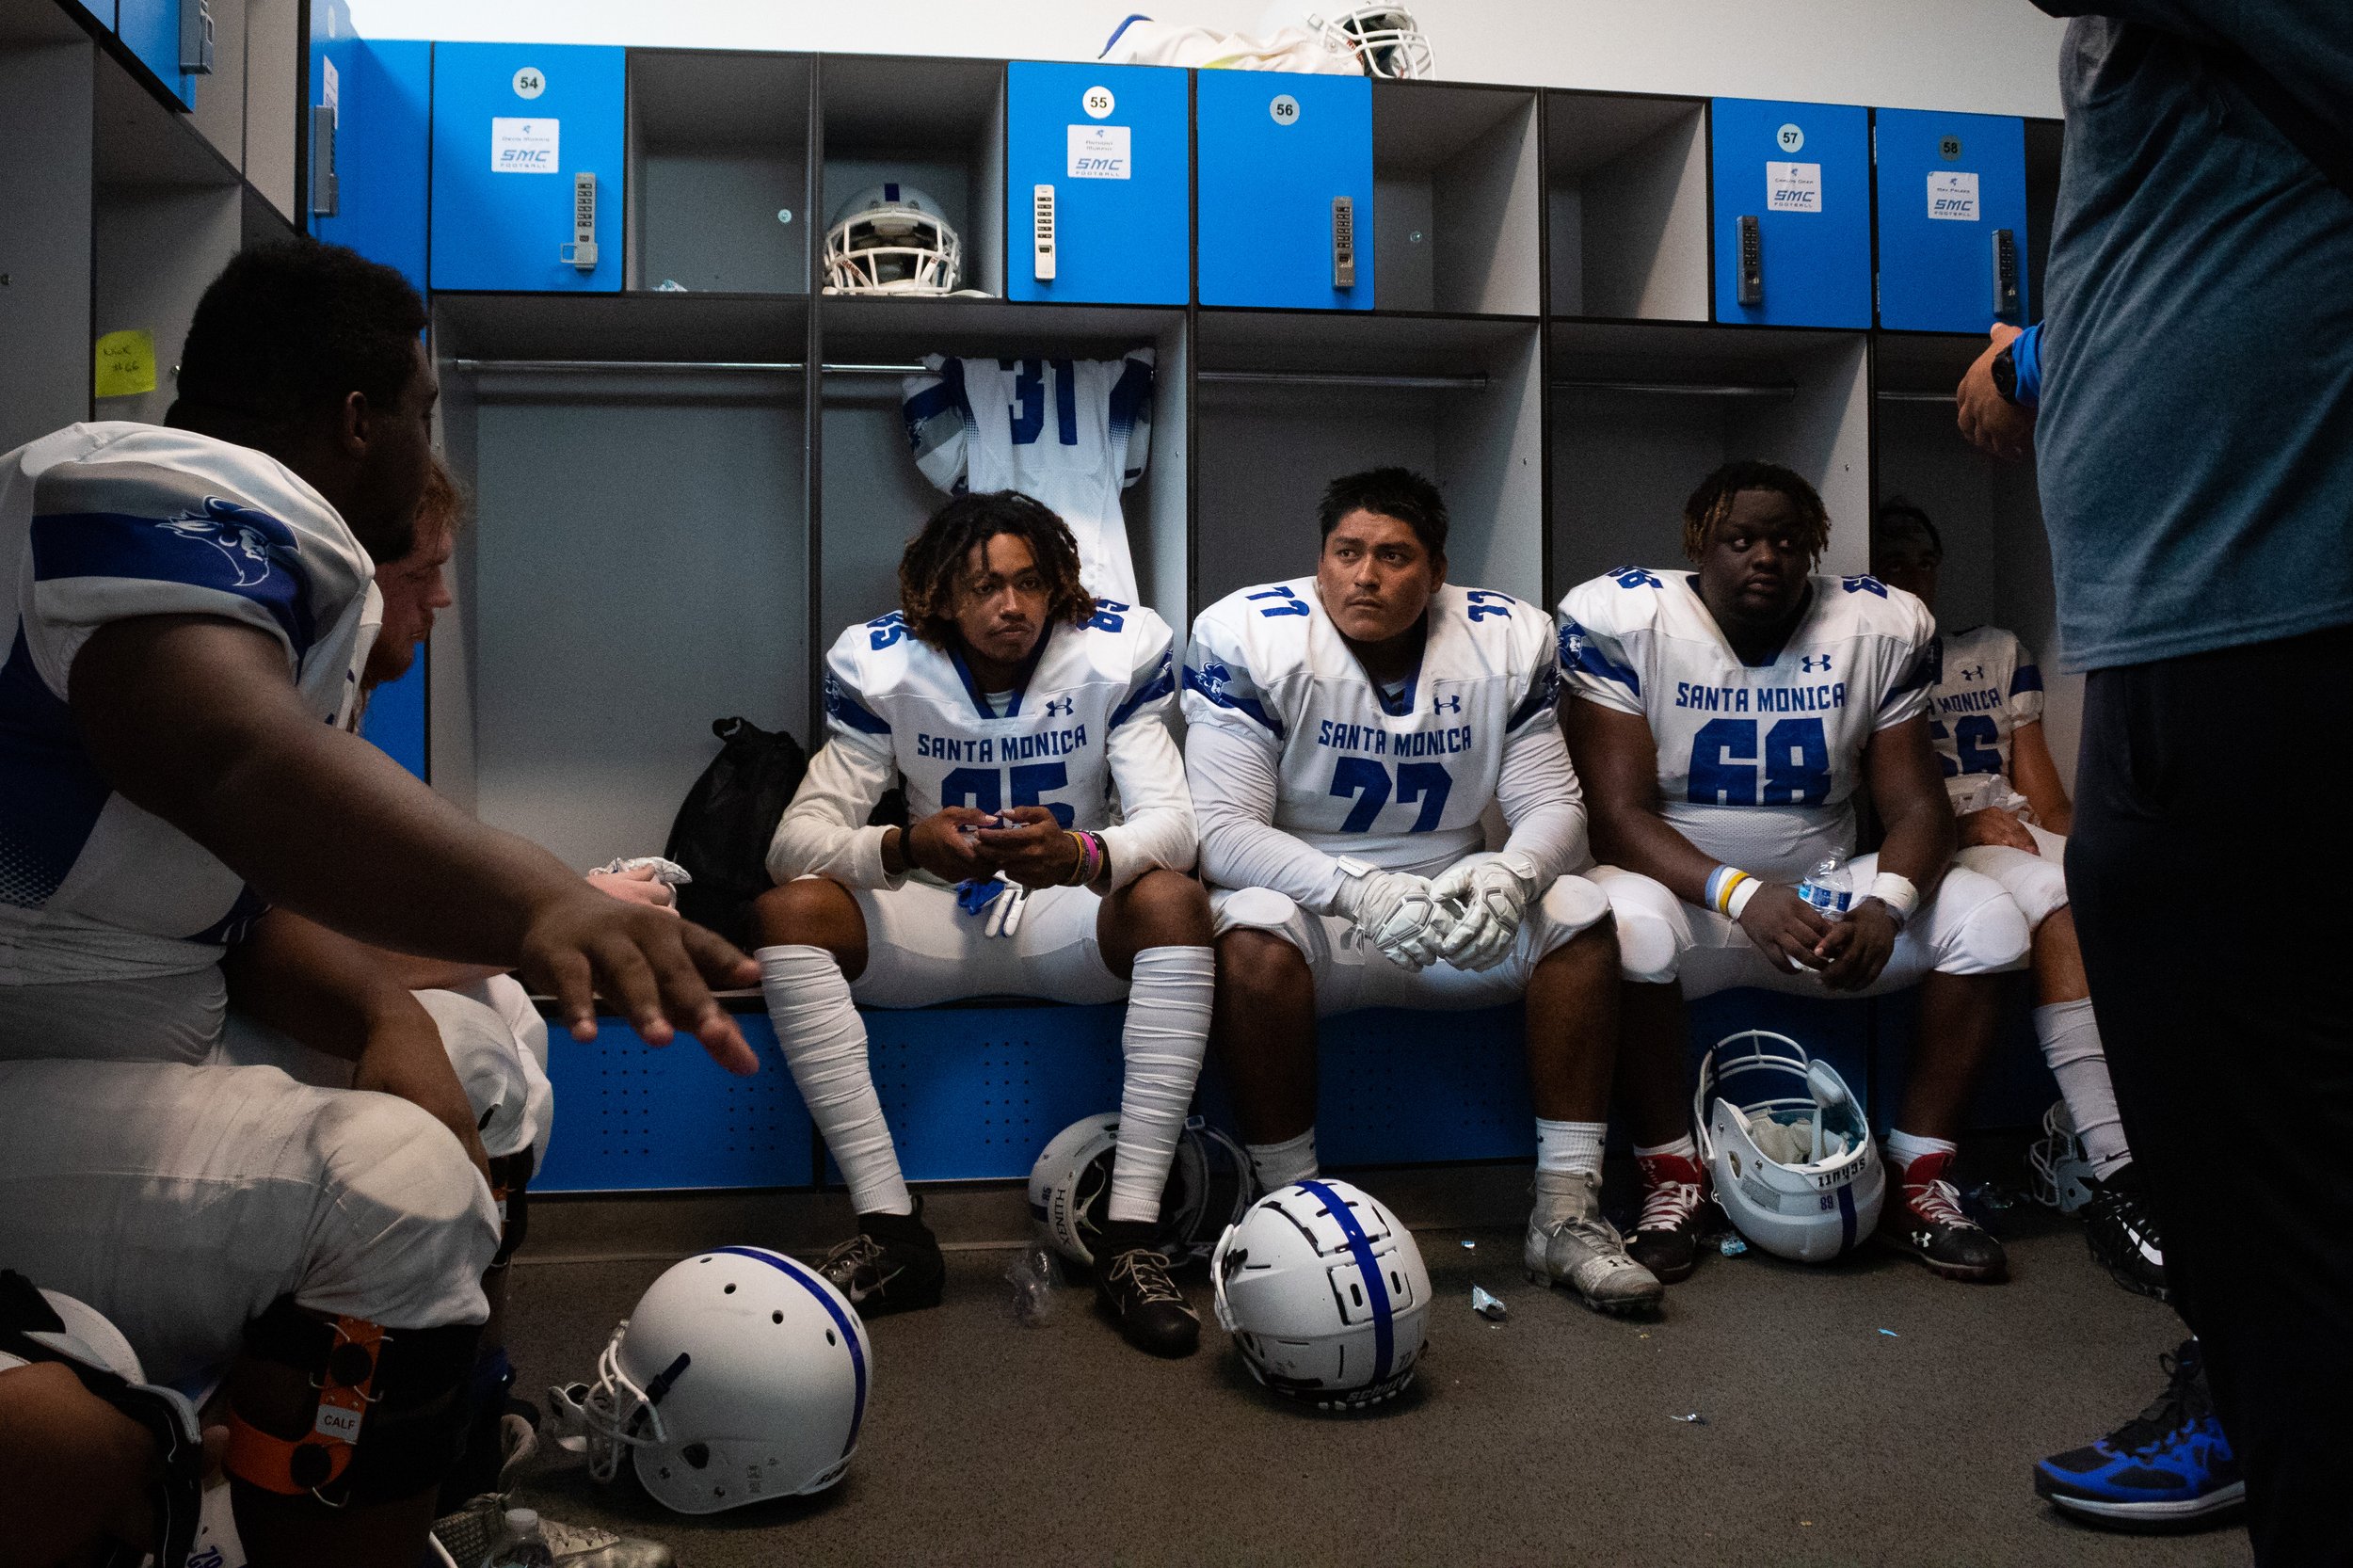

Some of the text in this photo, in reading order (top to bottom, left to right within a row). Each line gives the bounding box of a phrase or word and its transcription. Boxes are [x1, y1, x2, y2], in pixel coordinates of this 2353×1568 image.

[520, 76, 538, 89] 54
[1090, 96, 1108, 108] 55
[1276, 104, 1294, 117] 56
[1783, 132, 1799, 144] 57
[1943, 141, 1958, 153] 58
[500, 149, 551, 162] SMC
[1075, 157, 1124, 170] SMC
[1773, 189, 1816, 202] SMC
[1933, 199, 1974, 211] SMC
[998, 359, 1079, 446] 31
[1245, 585, 1310, 617] 77
[1466, 590, 1516, 622] 77
[1675, 681, 1846, 712] SANTA MONICA
[1937, 687, 2003, 713] MONICA
[917, 723, 1088, 762] SANTA MONICA
[1318, 720, 1472, 757] SANTA MONICA
[1687, 716, 1833, 807] 68
[1329, 756, 1453, 833] 77
[1053, 1188, 1071, 1245] XENITH
[324, 1415, 356, 1431] CALF
